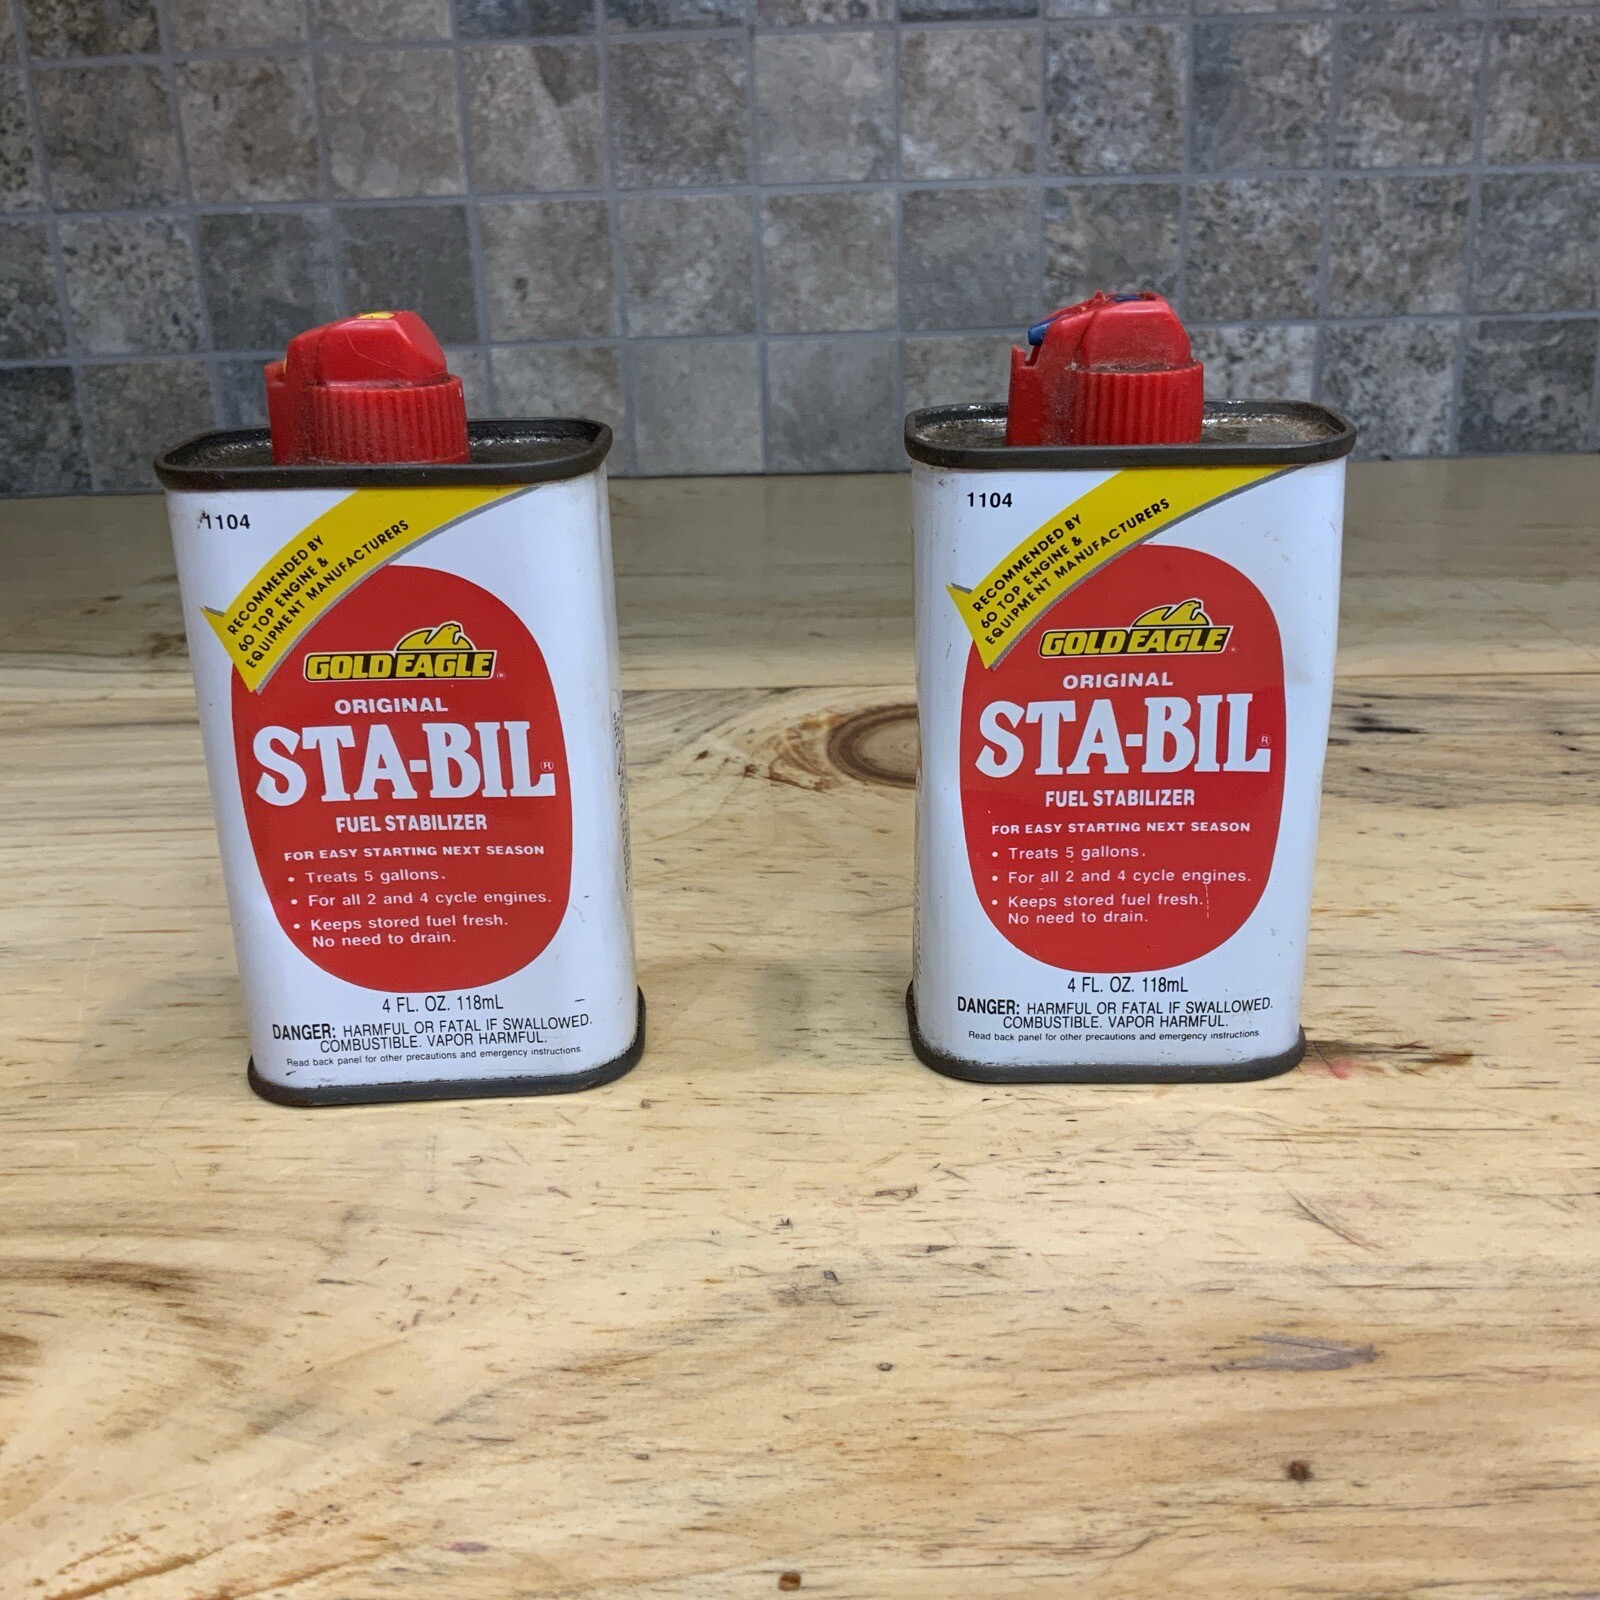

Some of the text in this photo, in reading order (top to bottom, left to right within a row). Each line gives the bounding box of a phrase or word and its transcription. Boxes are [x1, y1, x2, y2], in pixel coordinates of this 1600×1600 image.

[967, 492, 1013, 508] 1104
[204, 514, 250, 530] 1104
[972, 513, 1083, 612] RECOMMENDED BY
[985, 498, 1170, 645] EQUIPMENT MANUFACTURERS
[227, 535, 325, 635] RECOMMENDED BY
[981, 612, 996, 629] 60
[997, 584, 1022, 609] TOP
[1023, 545, 1070, 587] ENGINE
[246, 520, 409, 668] EQUIPMENT MANUFACTURERS
[239, 635, 255, 653] 60
[252, 606, 274, 633] TOP
[275, 567, 317, 608] ENGINE
[1063, 673, 1173, 689] ORIGINAL
[334, 698, 448, 714] ORIGINAL
[975, 693, 1271, 778] STA-BIL
[253, 721, 556, 806] STA-BIL
[1045, 790, 1195, 807] FUEL STABILIZER
[336, 814, 488, 833] FUEL STABILIZER
[992, 822, 1251, 834] FOR EASY STARTING NEXT SEASON
[284, 845, 544, 861] FOR EASY STARTING NEXT SEASON
[1008, 847, 1058, 859] Treats
[1065, 847, 1075, 859] 5
[305, 871, 357, 884] Treats
[365, 870, 374, 882] 5
[1008, 870, 1251, 885] For all 2 and 4 cycle engines.
[309, 890, 552, 907] For all 2 and 4 cycle engines.
[1008, 893, 1203, 911] Keeps stored fuel fresh.
[310, 913, 508, 934] Keeps stored fuel fresh.
[1008, 910, 1148, 924] No need to drain.
[313, 931, 456, 948] No need to drain.
[1068, 977, 1188, 993] 4 FL. OZ. 118mL
[382, 994, 503, 1013] 4 FL. OZ. 118mL
[957, 997, 1273, 1015] DANGER: HARMFUL OR FATAL IF SWALLOWED.
[272, 1013, 592, 1041] DANGER: HARMFUL OR FATAL IF SWALLOWED.
[1003, 1014, 1229, 1029] COMBUSTIBLE. VAPOR HARMFUL.
[320, 1030, 547, 1053] COMBUSTIBLE. VAPOR HARMFUL.
[968, 1031, 991, 1040] Read
[994, 1032, 1015, 1041] back
[1018, 1032, 1042, 1042] panel
[1045, 1032, 1057, 1041] for
[1060, 1032, 1082, 1041] other
[1085, 1032, 1136, 1043] precautions
[1139, 1032, 1156, 1040] and
[1159, 1032, 1207, 1042] emergency
[287, 1058, 309, 1067] Read
[312, 1057, 333, 1066] back
[337, 1056, 362, 1067] panel
[365, 1054, 377, 1063] for
[380, 1053, 403, 1062] other
[406, 1051, 457, 1063] precautions
[461, 1050, 477, 1058] and
[480, 1049, 527, 1060] emergency
